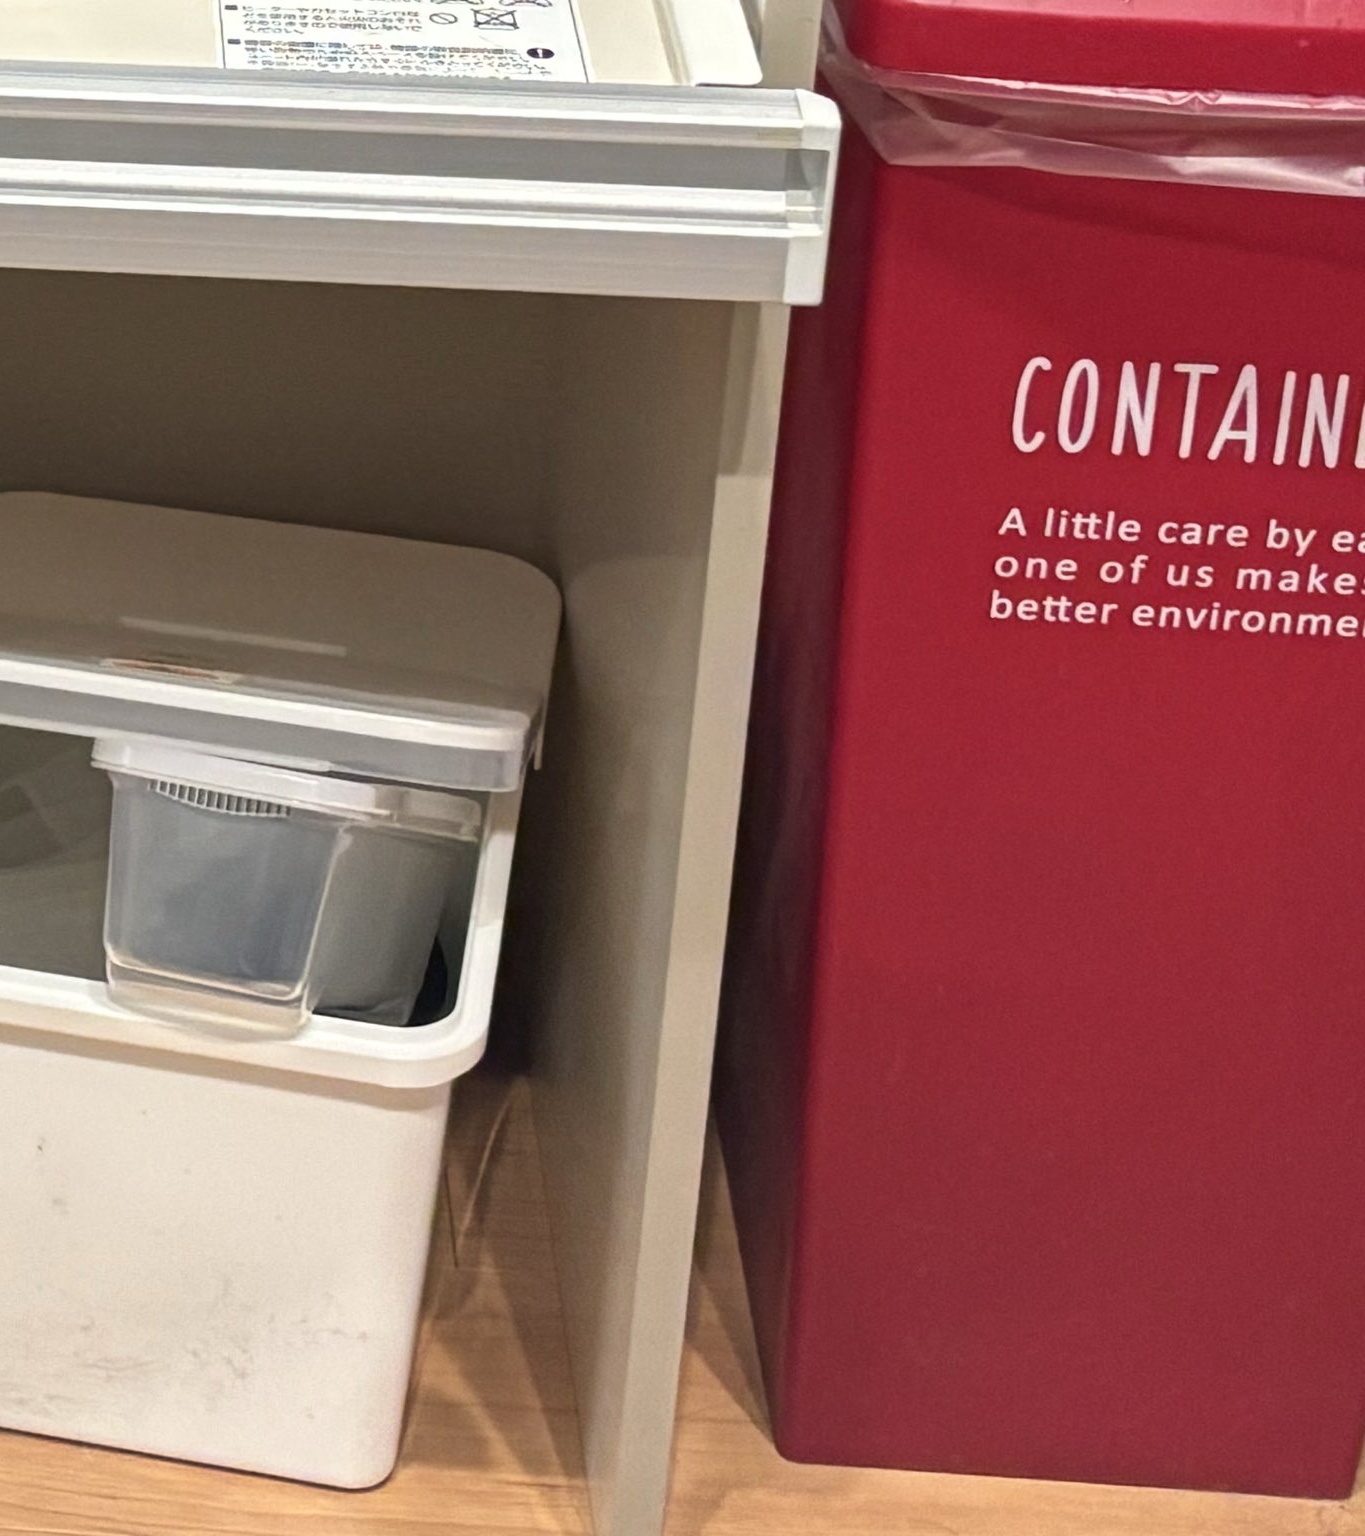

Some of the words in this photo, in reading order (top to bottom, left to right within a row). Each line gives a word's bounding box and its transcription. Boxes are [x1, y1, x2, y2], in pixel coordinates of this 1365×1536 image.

[998, 507, 1027, 537] A
[1044, 507, 1142, 542] little
[1157, 519, 1249, 547] care
[1266, 519, 1317, 557] by
[994, 554, 1078, 581] one
[1099, 554, 1150, 584] of
[1166, 564, 1215, 588] us
[1235, 563, 1365, 596] make
[989, 589, 1119, 624] better
[1131, 602, 1365, 639] environme
